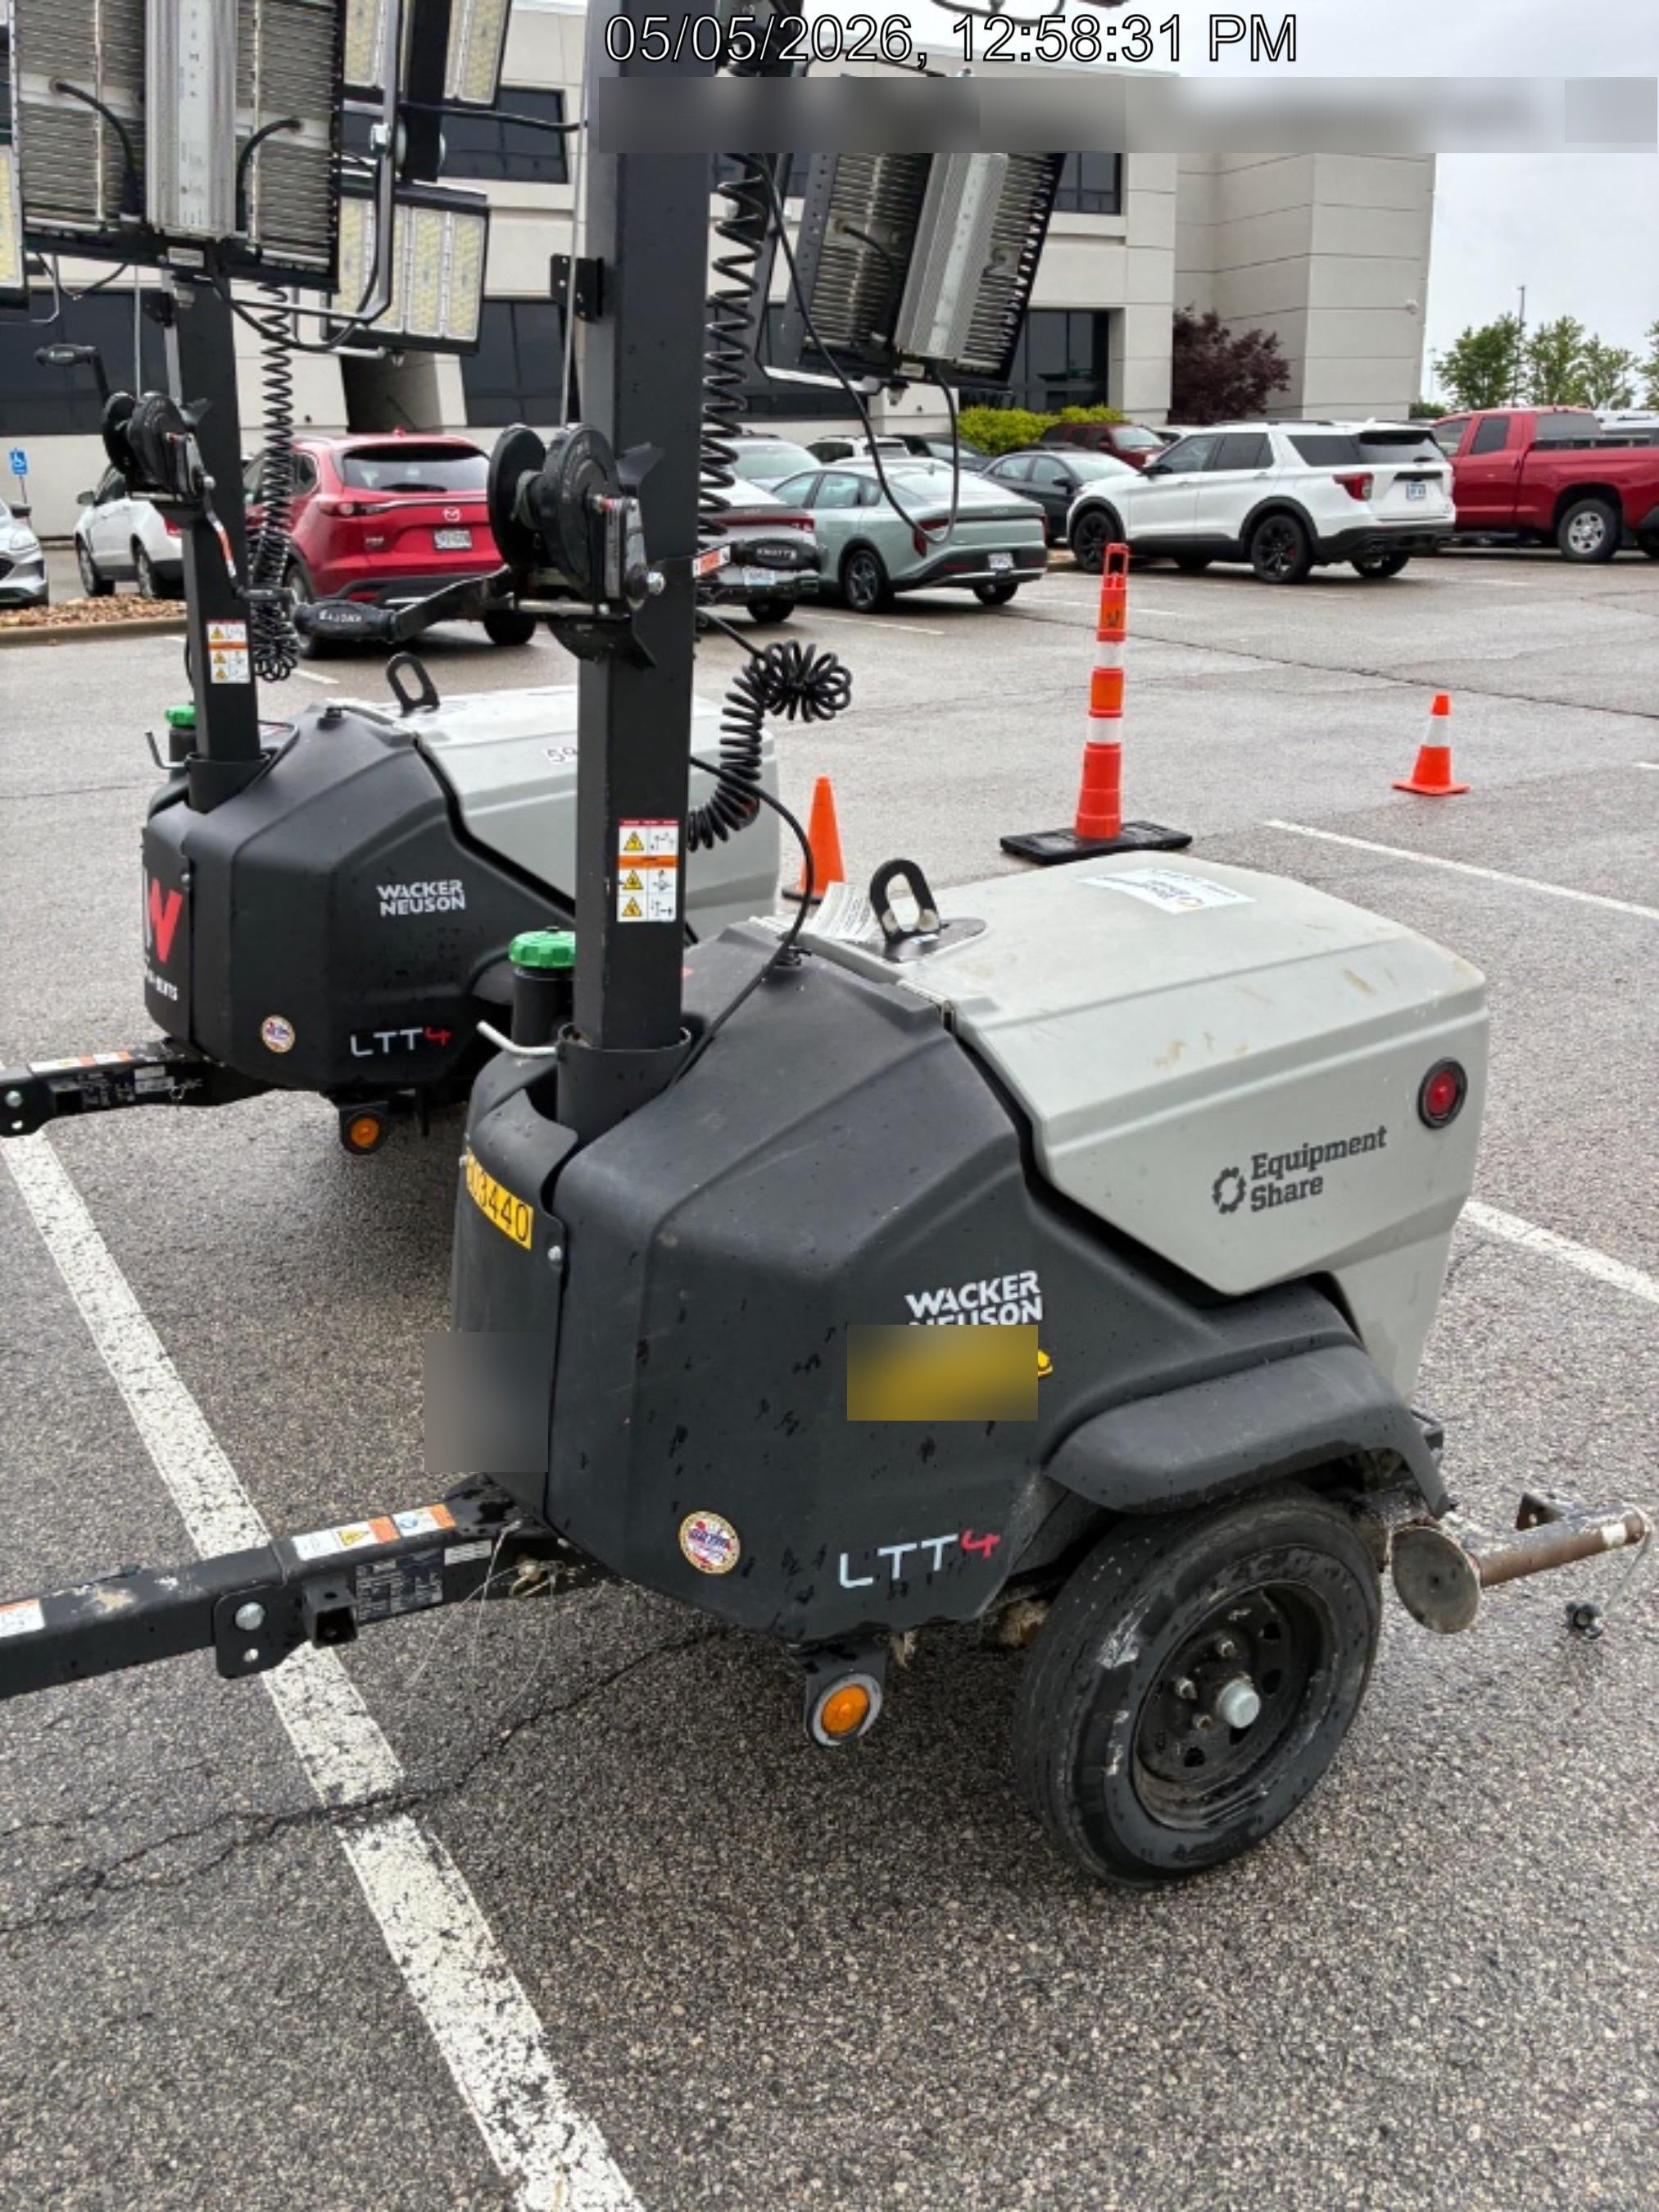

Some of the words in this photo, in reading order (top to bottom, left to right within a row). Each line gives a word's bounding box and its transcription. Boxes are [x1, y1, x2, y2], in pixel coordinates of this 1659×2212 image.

[376, 879, 464, 900] WACKER
[380, 892, 465, 917] NEUSON
[1251, 1125, 1387, 1181] Equipment
[468, 1166, 528, 1241] 3440
[1251, 1176, 1324, 1213] Share
[904, 1270, 1042, 1319] WACKER
[909, 1295, 1043, 1326] USON
